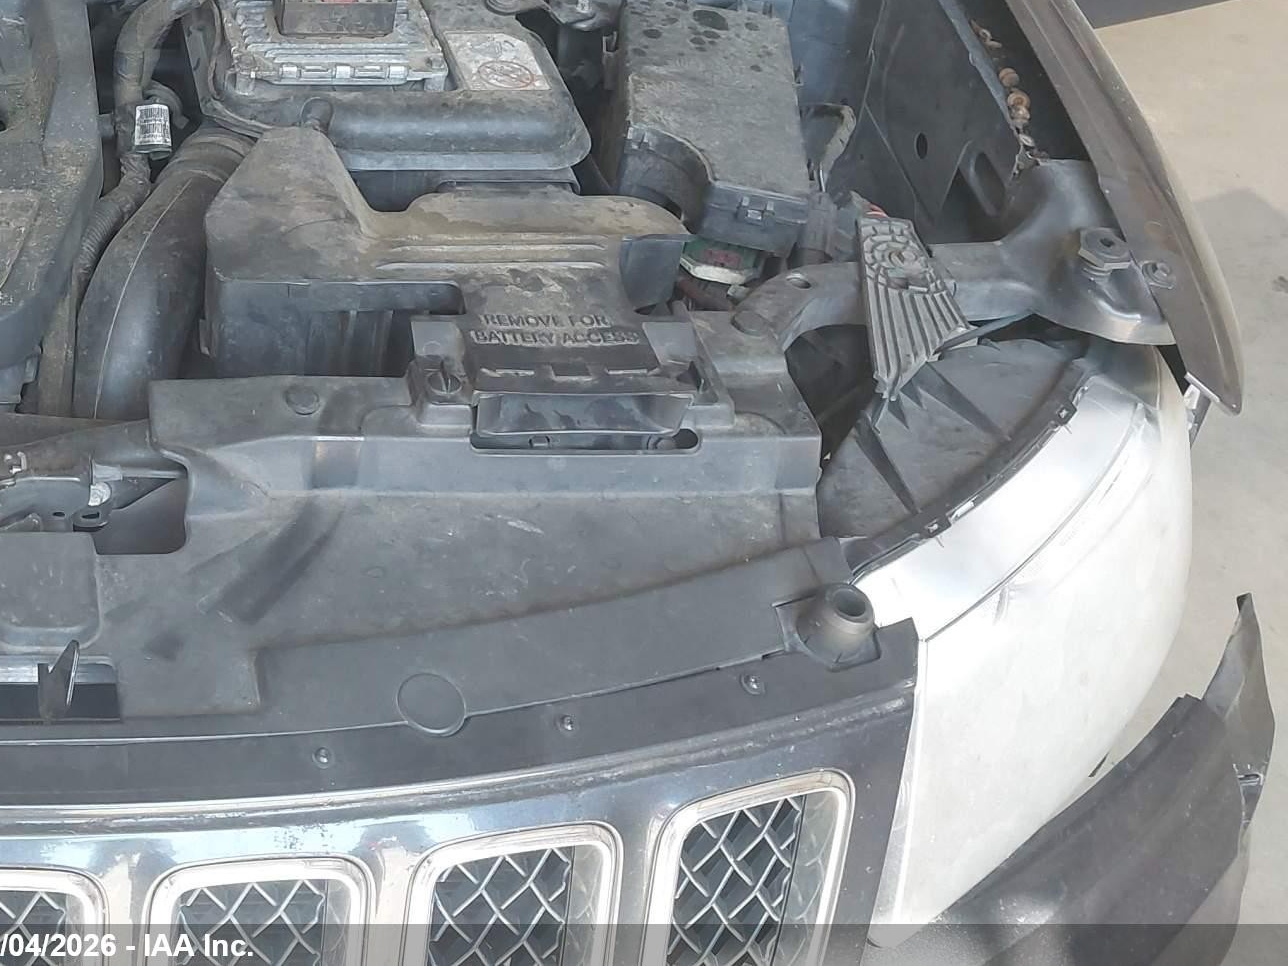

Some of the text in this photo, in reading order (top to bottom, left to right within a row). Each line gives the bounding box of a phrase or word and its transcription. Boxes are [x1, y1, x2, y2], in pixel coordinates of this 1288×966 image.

[482, 314, 611, 329] REMOVE FOR
[472, 331, 640, 346] BATTERY ACCESS
